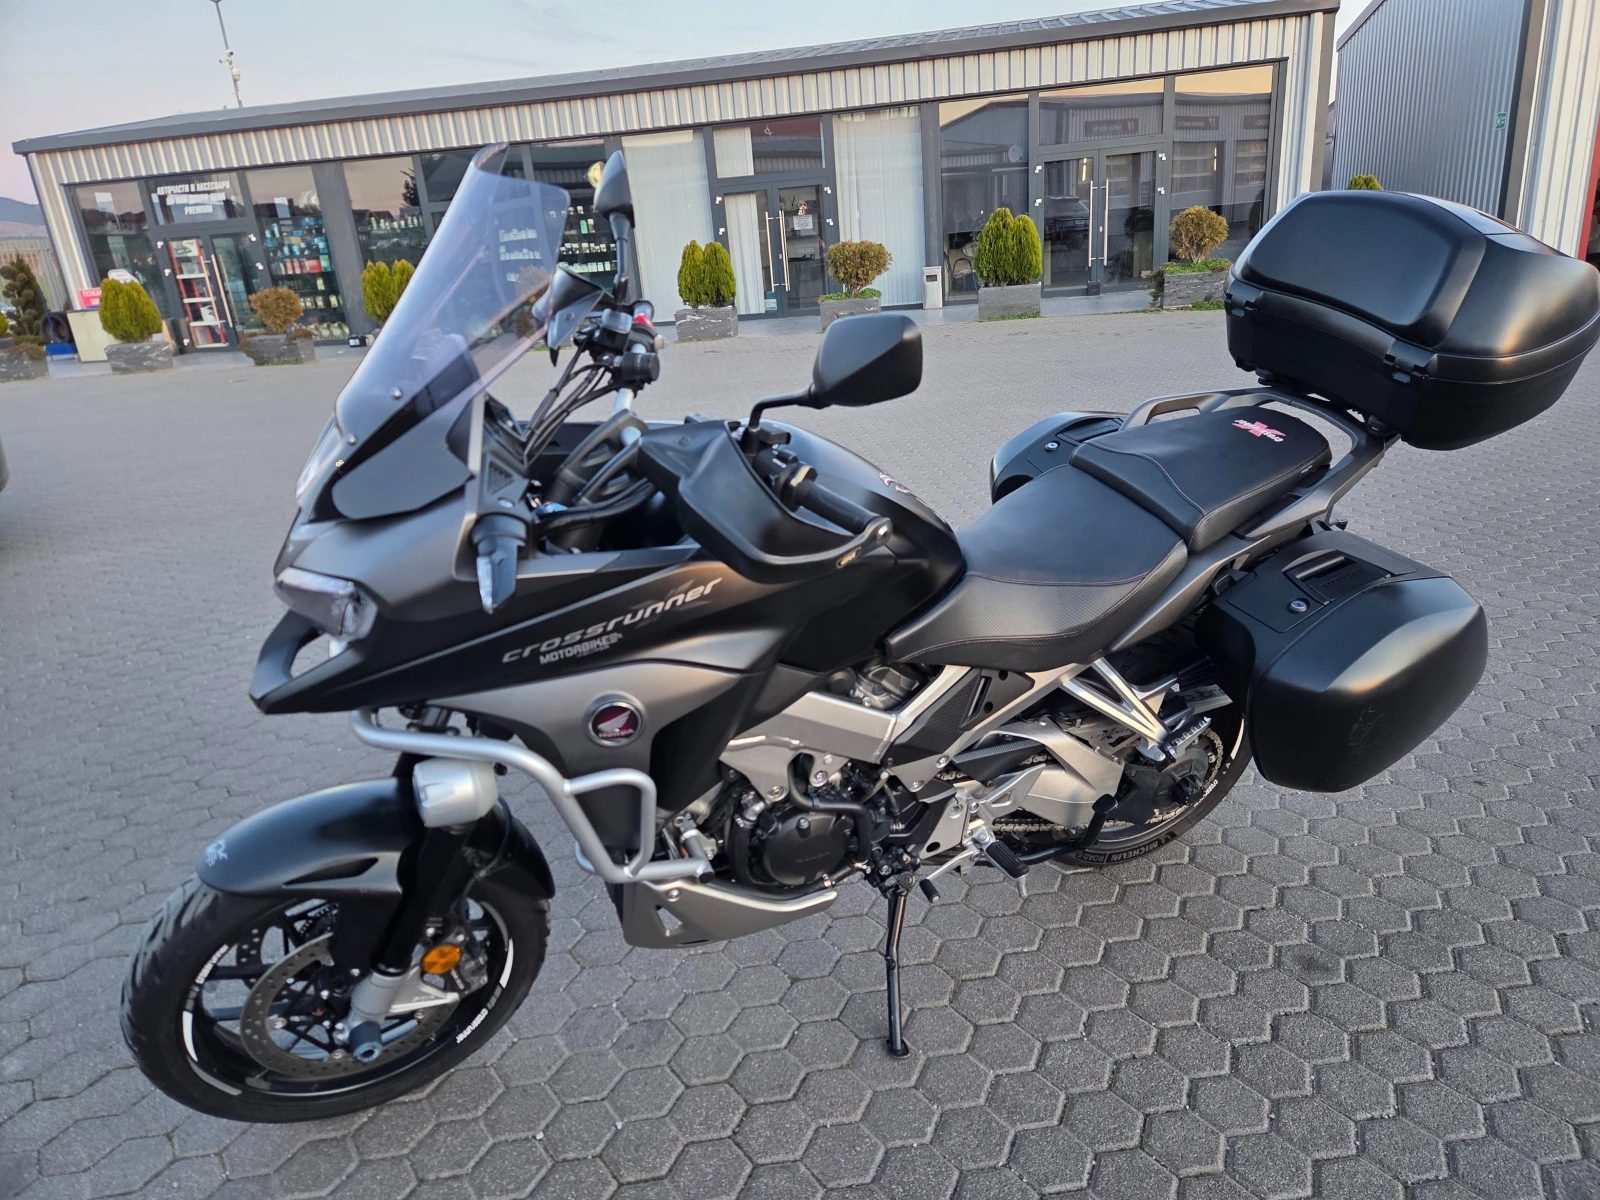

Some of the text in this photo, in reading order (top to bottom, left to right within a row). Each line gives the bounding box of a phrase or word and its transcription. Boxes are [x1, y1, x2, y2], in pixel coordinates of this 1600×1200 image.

[156, 180, 230, 196] АВТОЧАСТИ И АКСЕСОАРИ
[184, 205, 213, 215] PREMIUM
[501, 577, 722, 663] crossrunner
[1083, 852, 1105, 862] ROAD
[1110, 839, 1159, 862] MICHELIN
